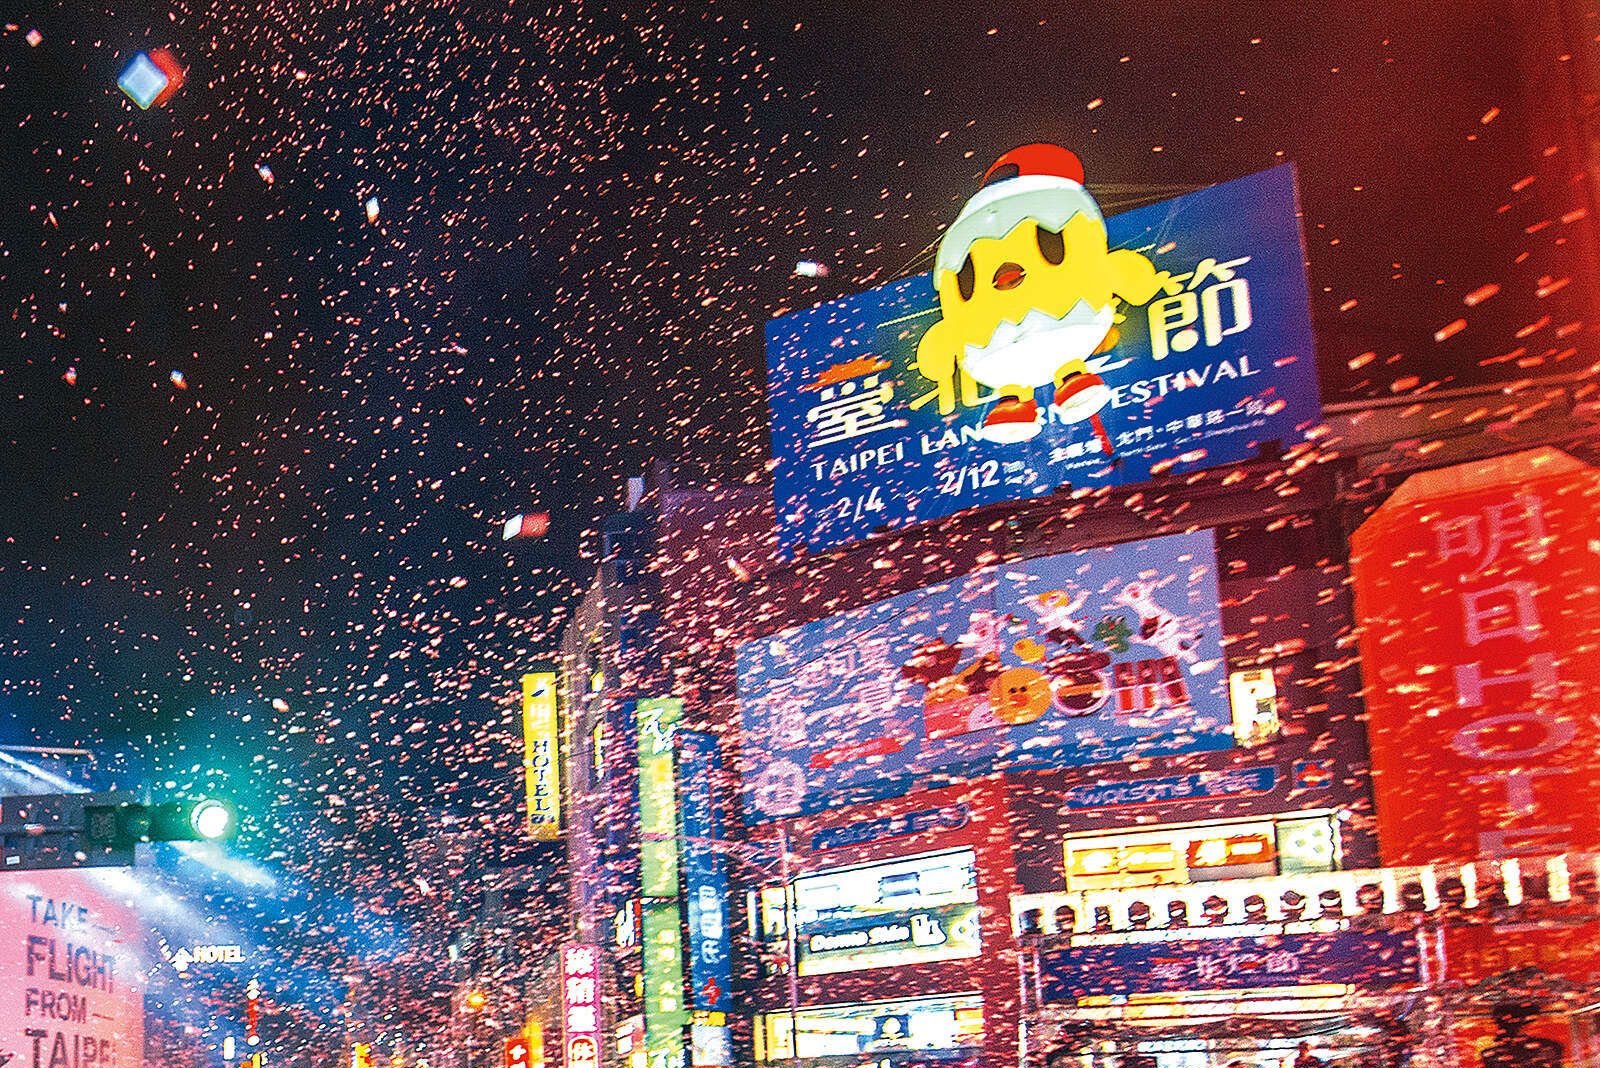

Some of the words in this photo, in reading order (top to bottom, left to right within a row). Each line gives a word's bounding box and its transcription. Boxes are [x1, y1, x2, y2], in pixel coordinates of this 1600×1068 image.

[809, 441, 905, 481] TAIPEI
[1109, 354, 1262, 410] ESTIVAL
[836, 485, 885, 523] 2/4
[939, 459, 1000, 496] 2/12
[532, 740, 551, 812] HOTEL
[1077, 777, 1194, 806] watsons
[25, 894, 90, 932] TAKE
[26, 935, 115, 994] FLIGHT
[193, 945, 246, 964] HOTEL
[25, 988, 88, 1024] FROM
